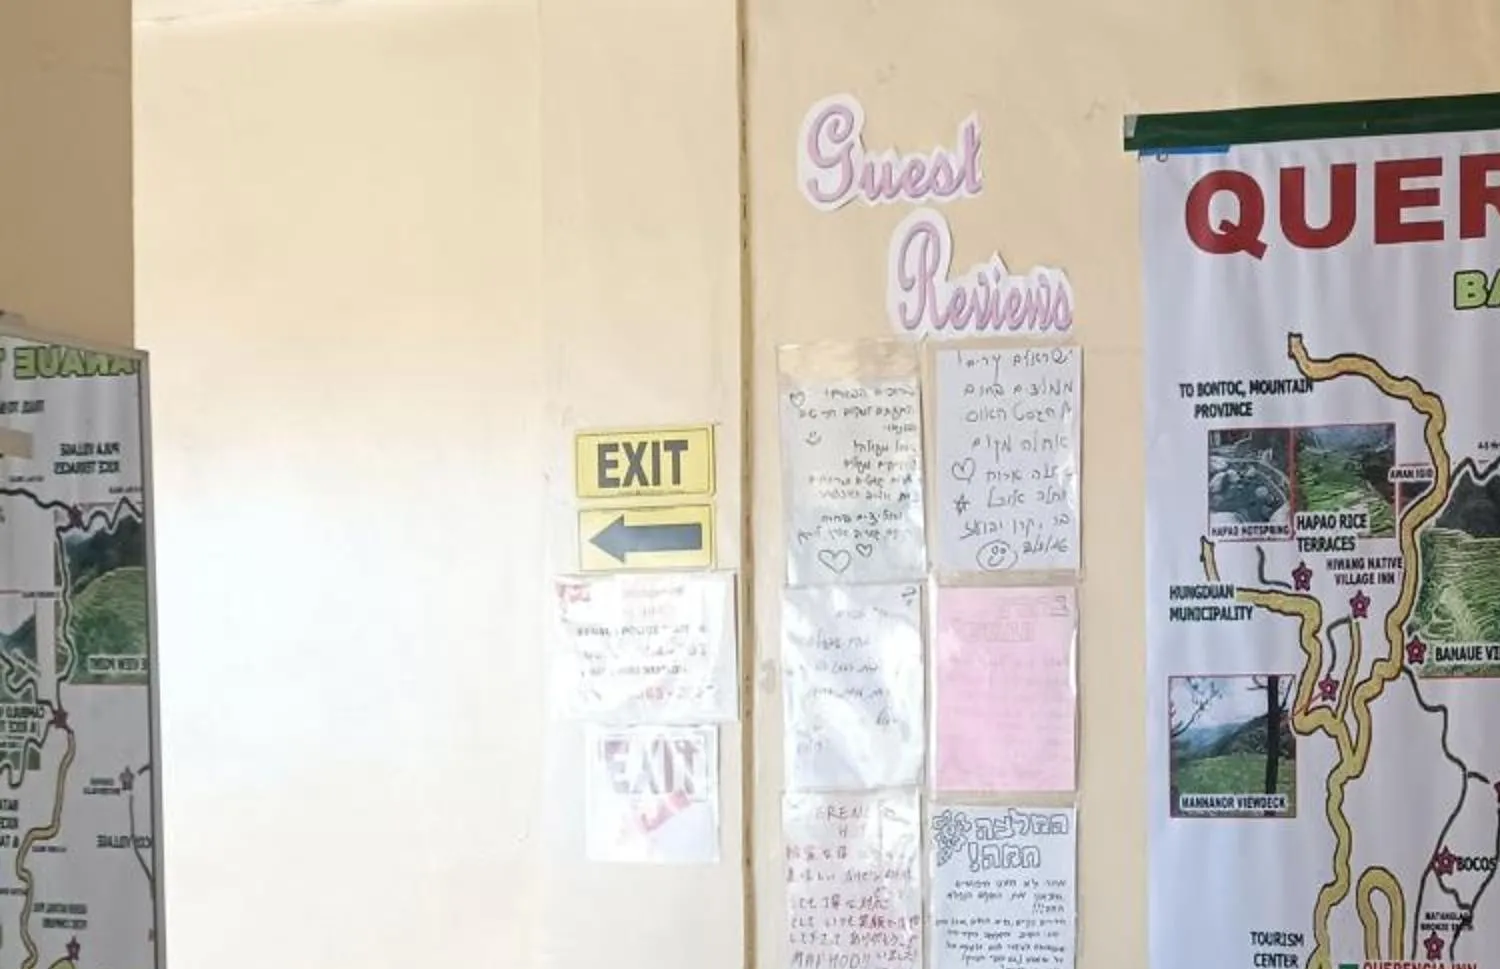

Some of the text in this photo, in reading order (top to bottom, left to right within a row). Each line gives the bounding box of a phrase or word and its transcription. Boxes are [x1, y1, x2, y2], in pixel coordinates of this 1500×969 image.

[805, 102, 984, 203] Guest
[898, 220, 1074, 331] Reviews
[1179, 378, 1314, 400] TO BONTOC, MOUNTAIN
[1194, 403, 1253, 419] PROVINCE
[597, 439, 689, 489] EXIT
[1297, 513, 1367, 531] HAPAO RICE
[1297, 536, 1356, 552] TERRACES
[1367, 556, 1403, 569] NATIVE
[1335, 572, 1395, 586] VILLAGE INN
[1169, 605, 1253, 622] MUNICIPALITY
[1435, 646, 1484, 661] BANAUE
[1457, 856, 1497, 872] BOCOS
[1250, 931, 1304, 947] TOURISM
[1253, 953, 1299, 969] CENTER
